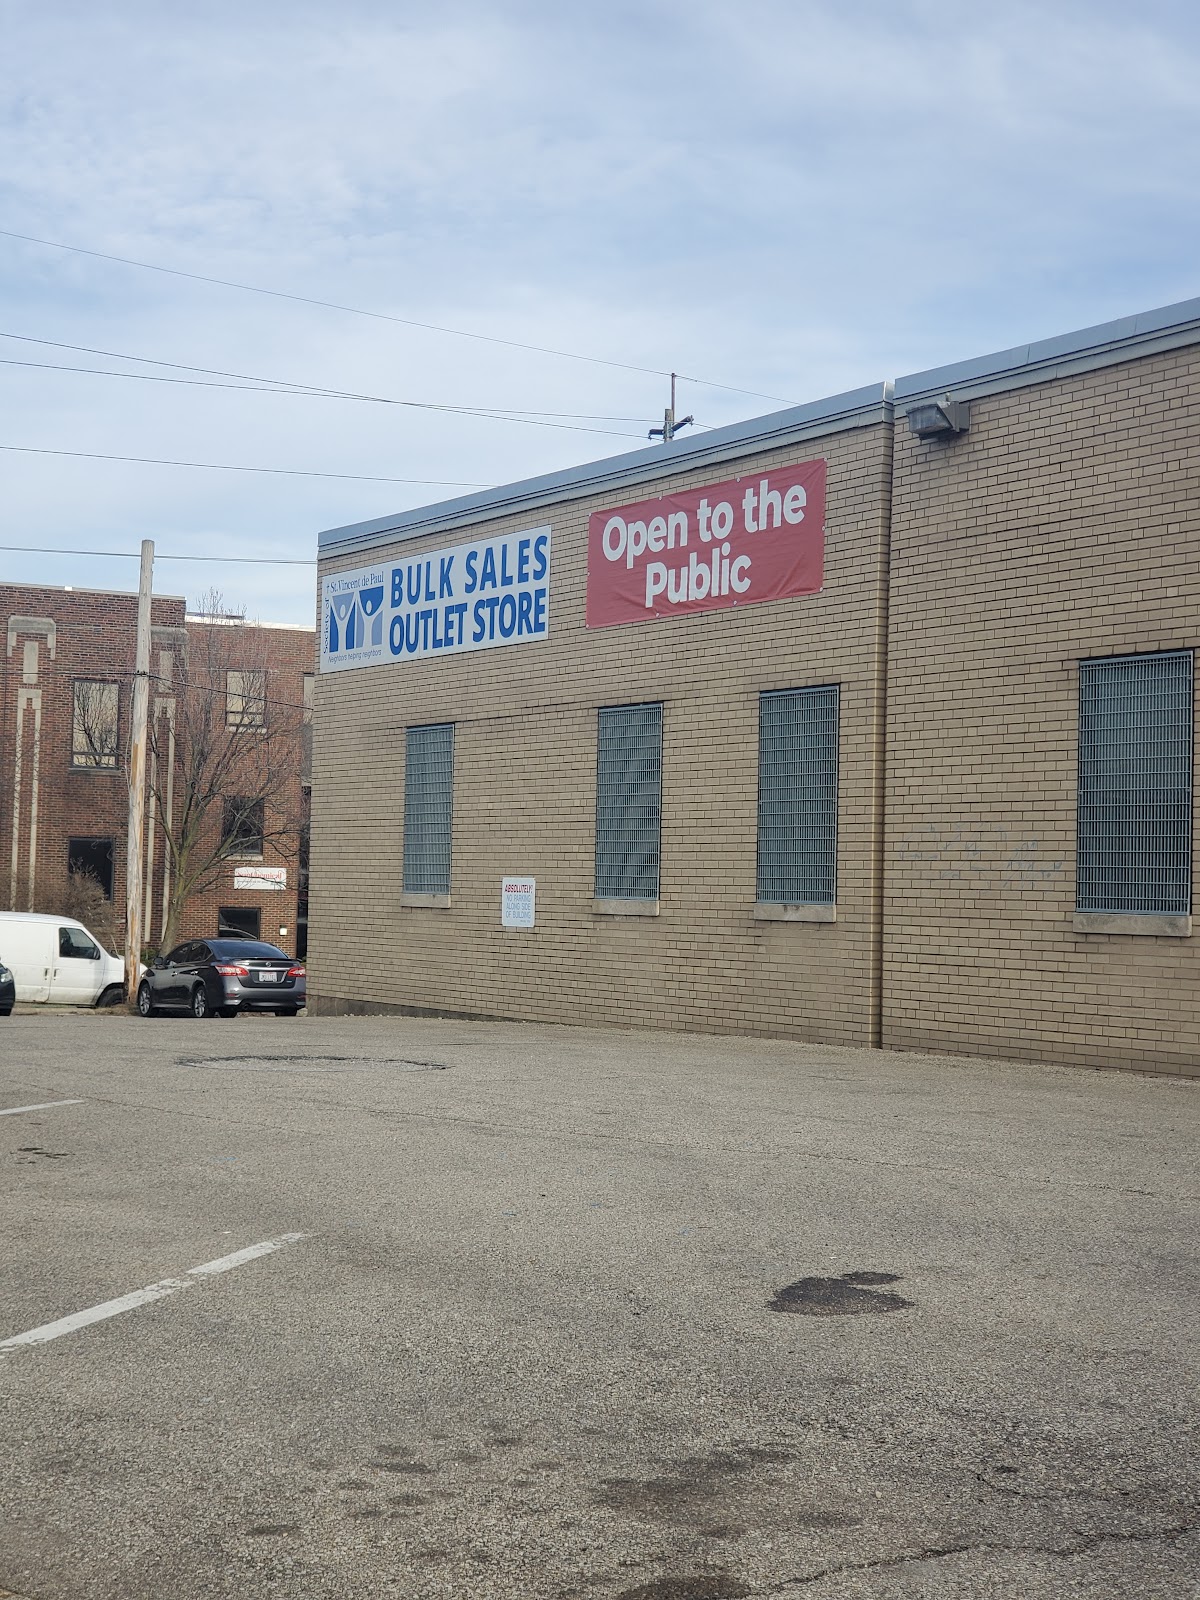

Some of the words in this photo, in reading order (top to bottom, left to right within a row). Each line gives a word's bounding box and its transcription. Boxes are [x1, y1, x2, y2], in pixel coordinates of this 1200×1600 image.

[602, 511, 688, 569] Open
[697, 498, 734, 542] to
[742, 479, 807, 533] the
[390, 555, 455, 608] BULK
[465, 535, 548, 594] SALES
[645, 542, 752, 608] Public
[338, 579, 360, 591] Vincent
[361, 575, 369, 587] de
[370, 571, 384, 585] Paul
[324, 597, 330, 610] of
[389, 602, 468, 656] OUTLET
[472, 588, 547, 642] STORE
[328, 653, 347, 664] Neighbors
[347, 651, 362, 661] helping
[362, 648, 382, 659] neighbors
[506, 894, 513, 902] NO
[513, 894, 531, 903] PARKING
[506, 902, 520, 910] ALONG
[521, 902, 531, 911] SIDE
[505, 910, 512, 918] OF
[512, 910, 531, 919] BUILDING
